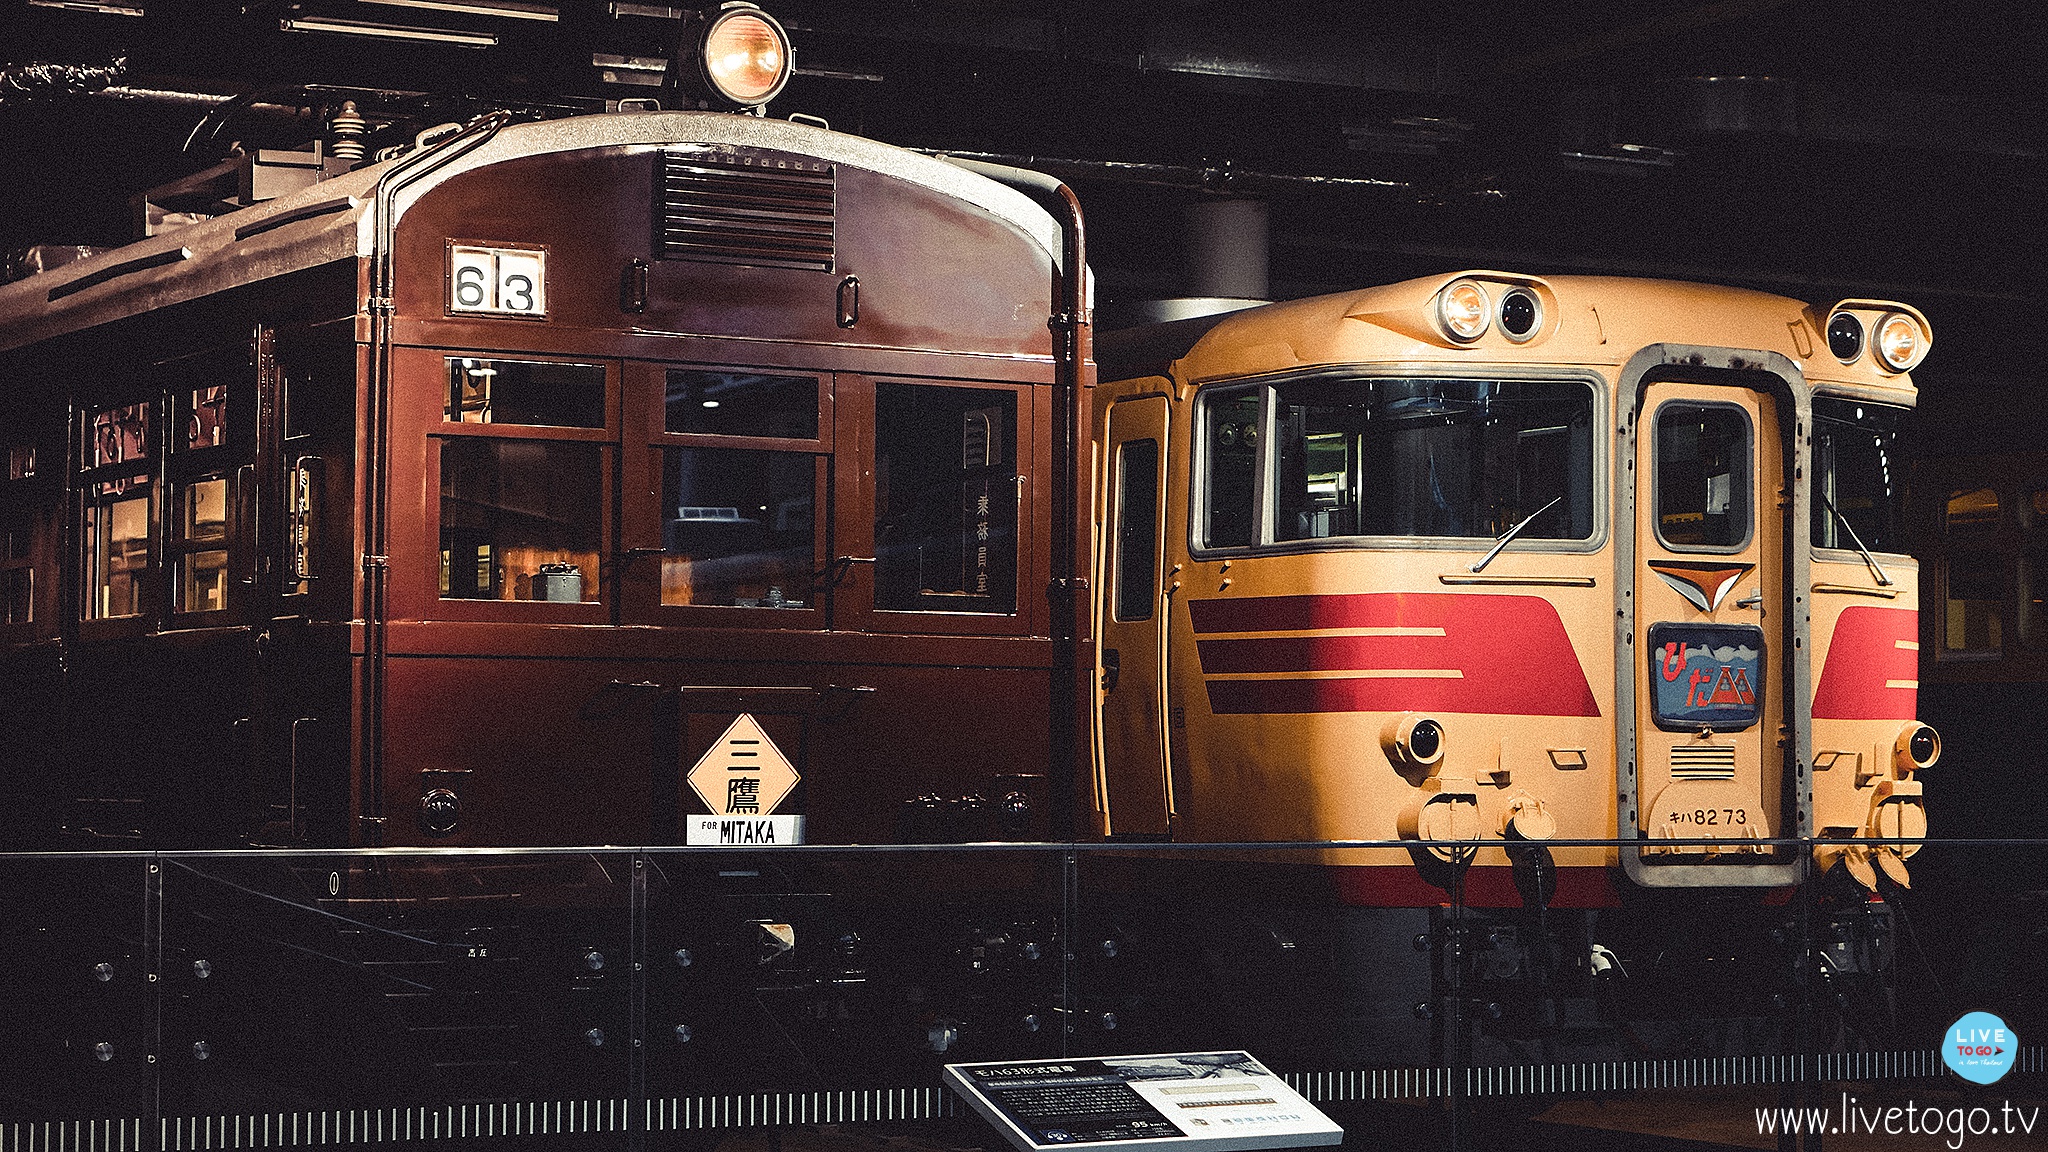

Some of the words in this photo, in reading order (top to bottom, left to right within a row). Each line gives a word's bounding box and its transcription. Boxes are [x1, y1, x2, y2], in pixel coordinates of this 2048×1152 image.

[725, 740, 761, 814] 三鷹
[701, 821, 718, 830] FOR
[720, 820, 775, 844] MITAKA
[1131, 1120, 1149, 1128] 95
